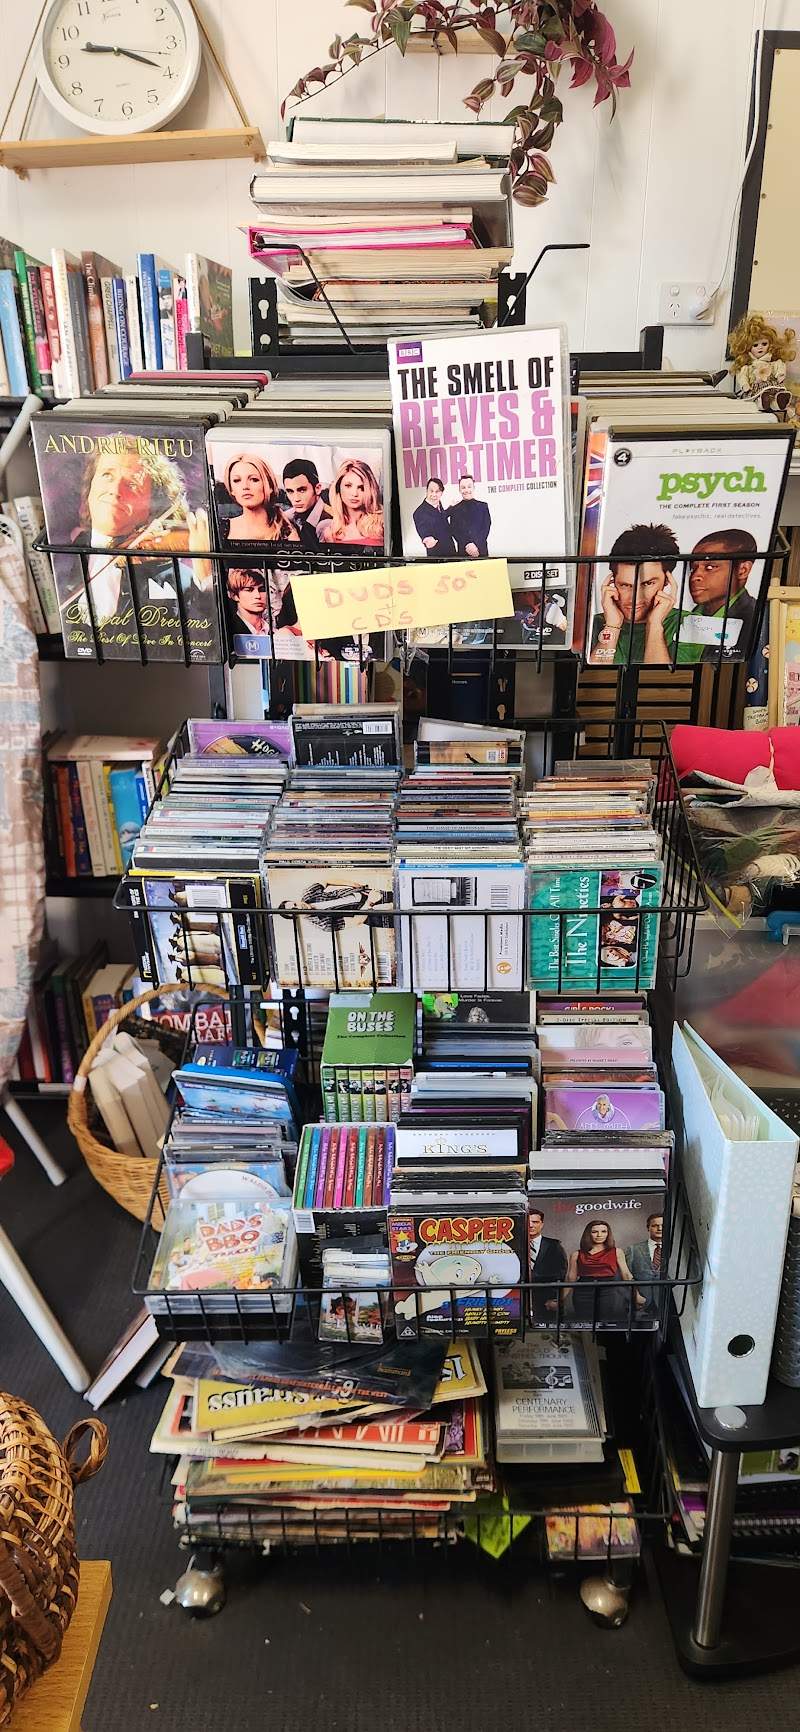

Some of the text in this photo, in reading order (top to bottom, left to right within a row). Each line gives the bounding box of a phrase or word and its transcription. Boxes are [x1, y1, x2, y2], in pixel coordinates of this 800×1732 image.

[77, 1, 90, 16] 11
[154, 8, 165, 22] 2
[61, 25, 80, 41] 10
[166, 35, 177, 50] 3
[58, 55, 70, 69] 9
[162, 66, 174, 79] 4
[72, 82, 83, 96] 8
[147, 89, 158, 104] 5
[94, 98, 104, 113] 7
[121, 102, 133, 116] 6
[116, 289, 126, 315] RIDING
[397, 356, 554, 400] THE SMELL OF
[400, 389, 556, 449] REEVES &
[45, 431, 193, 458] ANDRÉ RIEU
[402, 438, 557, 489] MORTIMER
[617, 452, 628, 463] 4
[487, 481, 557, 494] THE COMPLETE COLLECTION
[656, 466, 767, 501] psych
[65, 603, 134, 632] Ryal
[77, 647, 93, 656] DVD
[595, 648, 616, 656] DVD
[564, 941, 588, 968] The
[152, 1010, 232, 1031] OMBAT
[348, 1011, 396, 1022] ON THE
[347, 1022, 395, 1033] BUSES
[424, 1143, 488, 1154] KING'S
[575, 1199, 642, 1215] goodwife
[419, 1217, 514, 1243] CASPER
[207, 1230, 260, 1252] BBQ
[515, 1397, 567, 1406] CENTENARY
[512, 1406, 575, 1415] PERFORMANCE
